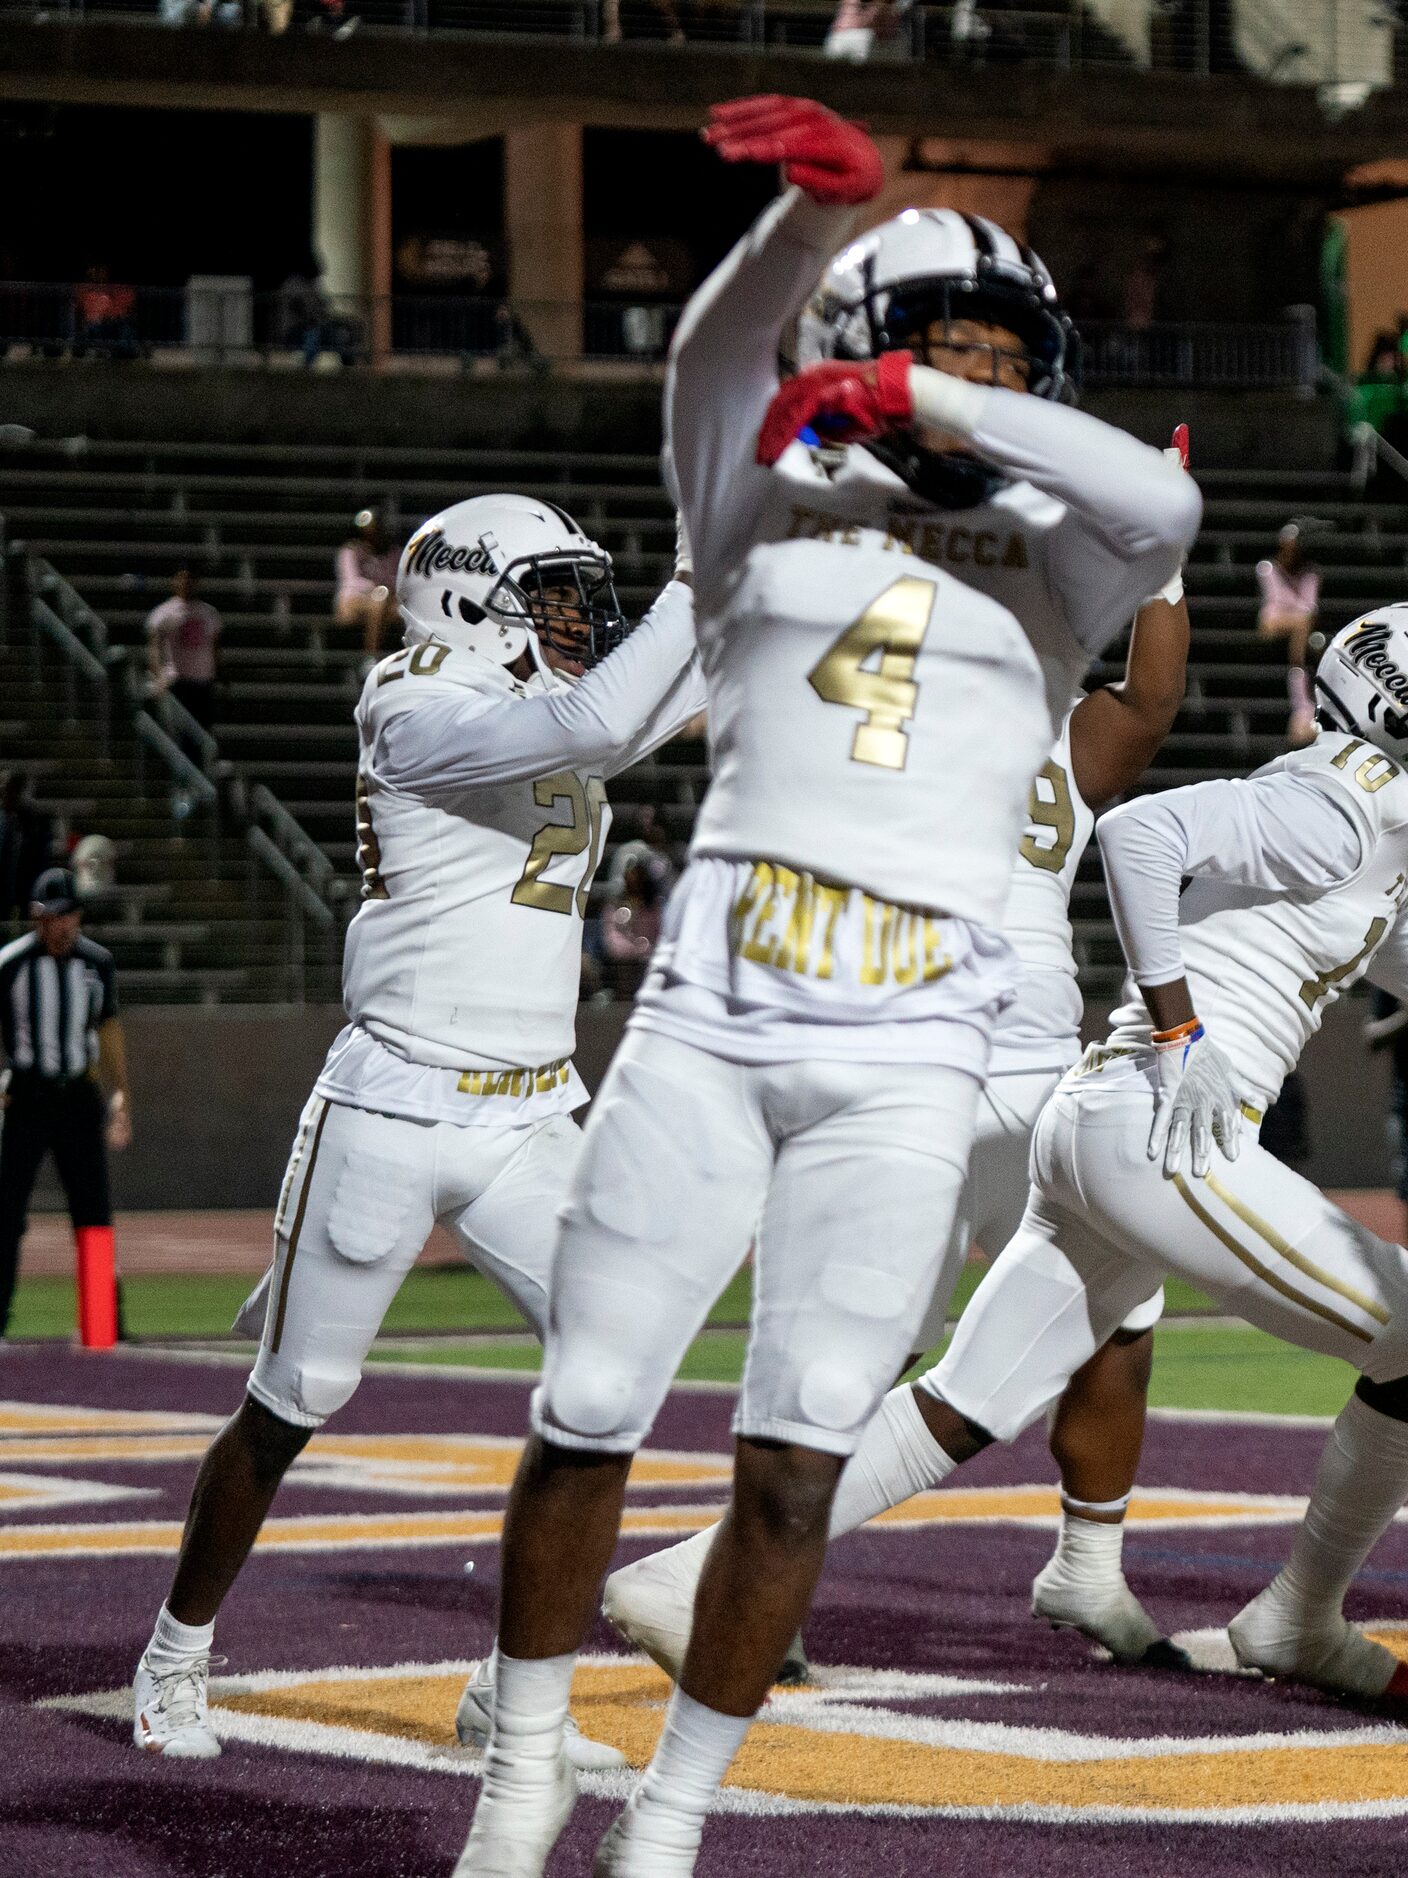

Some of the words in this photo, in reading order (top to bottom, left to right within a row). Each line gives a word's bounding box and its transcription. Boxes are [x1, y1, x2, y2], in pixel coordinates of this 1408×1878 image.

[883, 514, 1030, 570] MECCA
[806, 573, 938, 771] 4
[1330, 738, 1400, 794] 10
